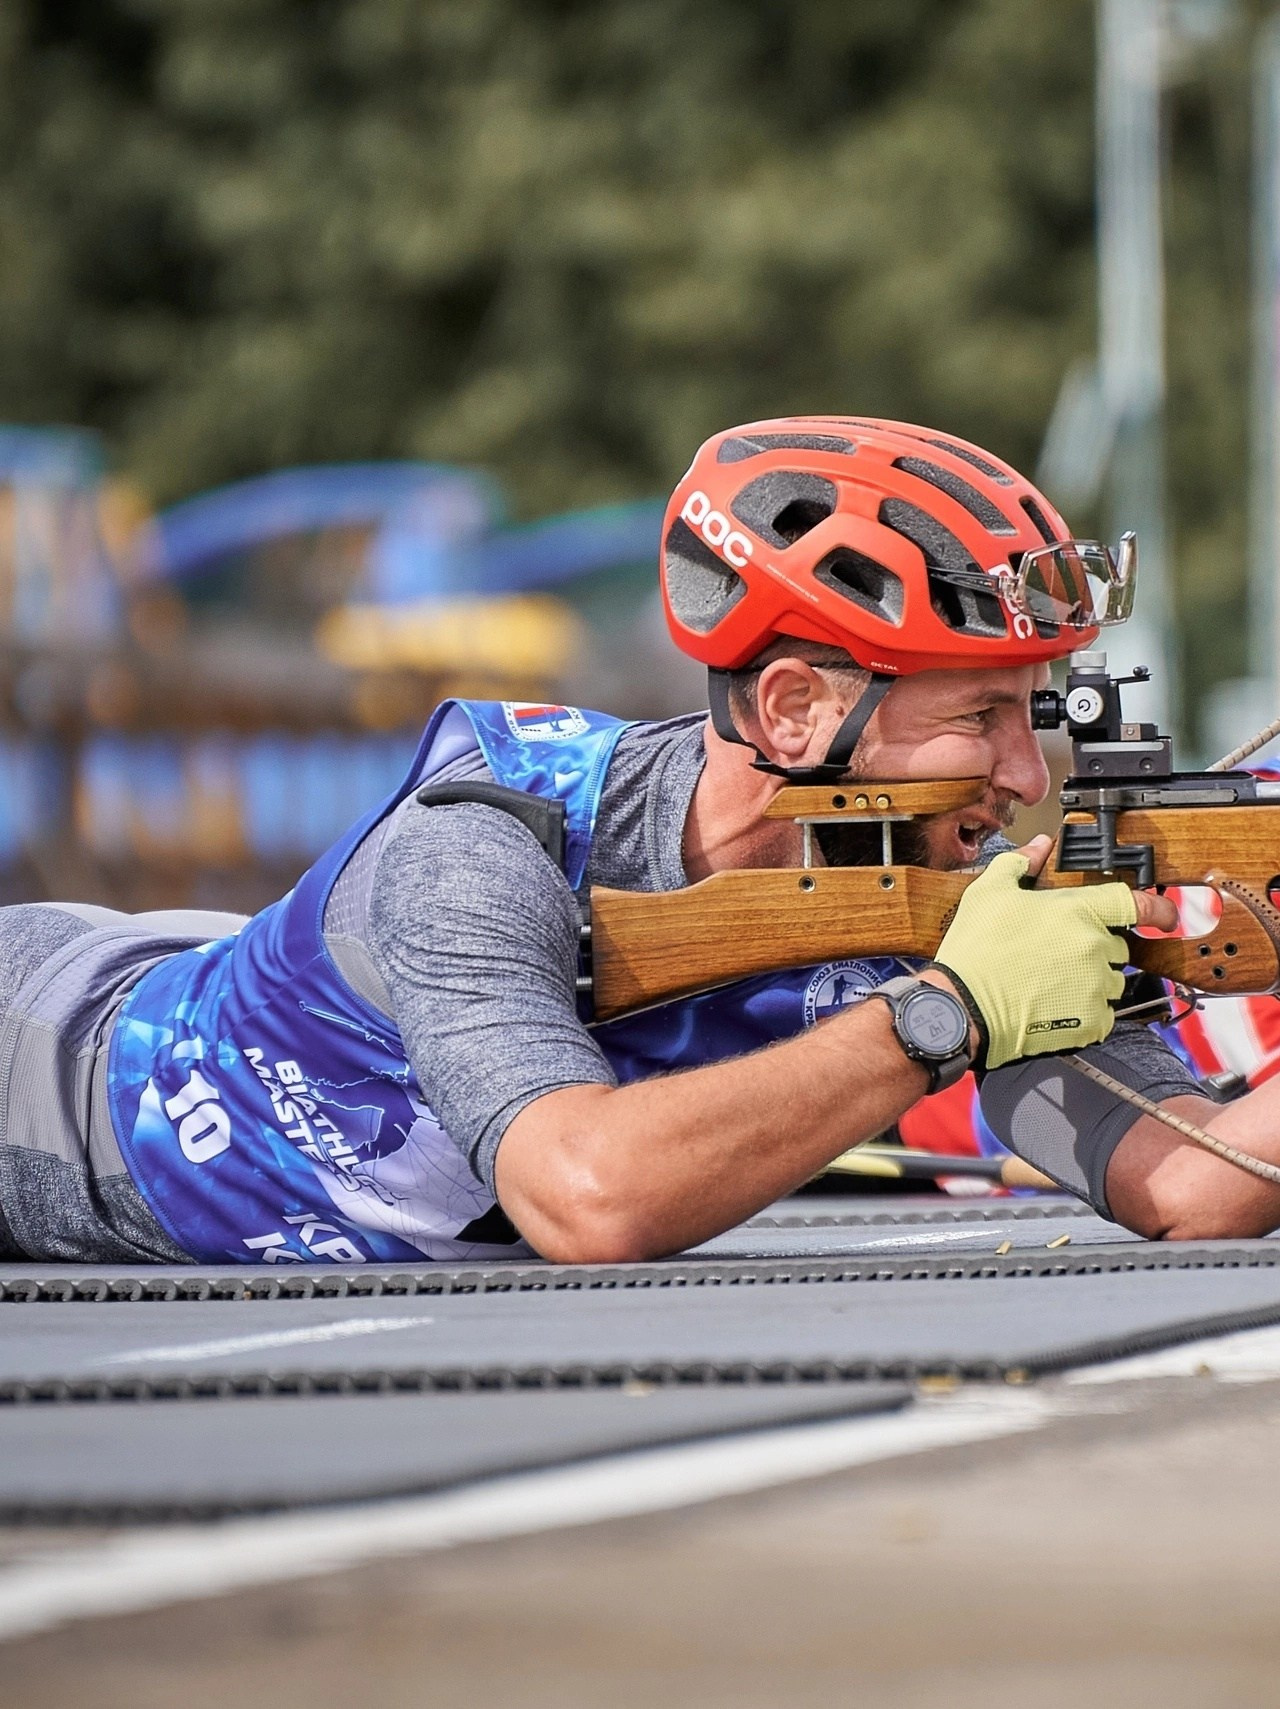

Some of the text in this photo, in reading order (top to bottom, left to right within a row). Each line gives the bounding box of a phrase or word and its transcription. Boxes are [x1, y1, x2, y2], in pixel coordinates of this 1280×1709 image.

[680, 491, 753, 567] POC
[809, 961, 883, 993] СОЮЗ БИАТЛОНИС
[806, 1005, 815, 1026] КРА
[165, 1070, 231, 1163] 10
[243, 1047, 361, 1191] MASTES
